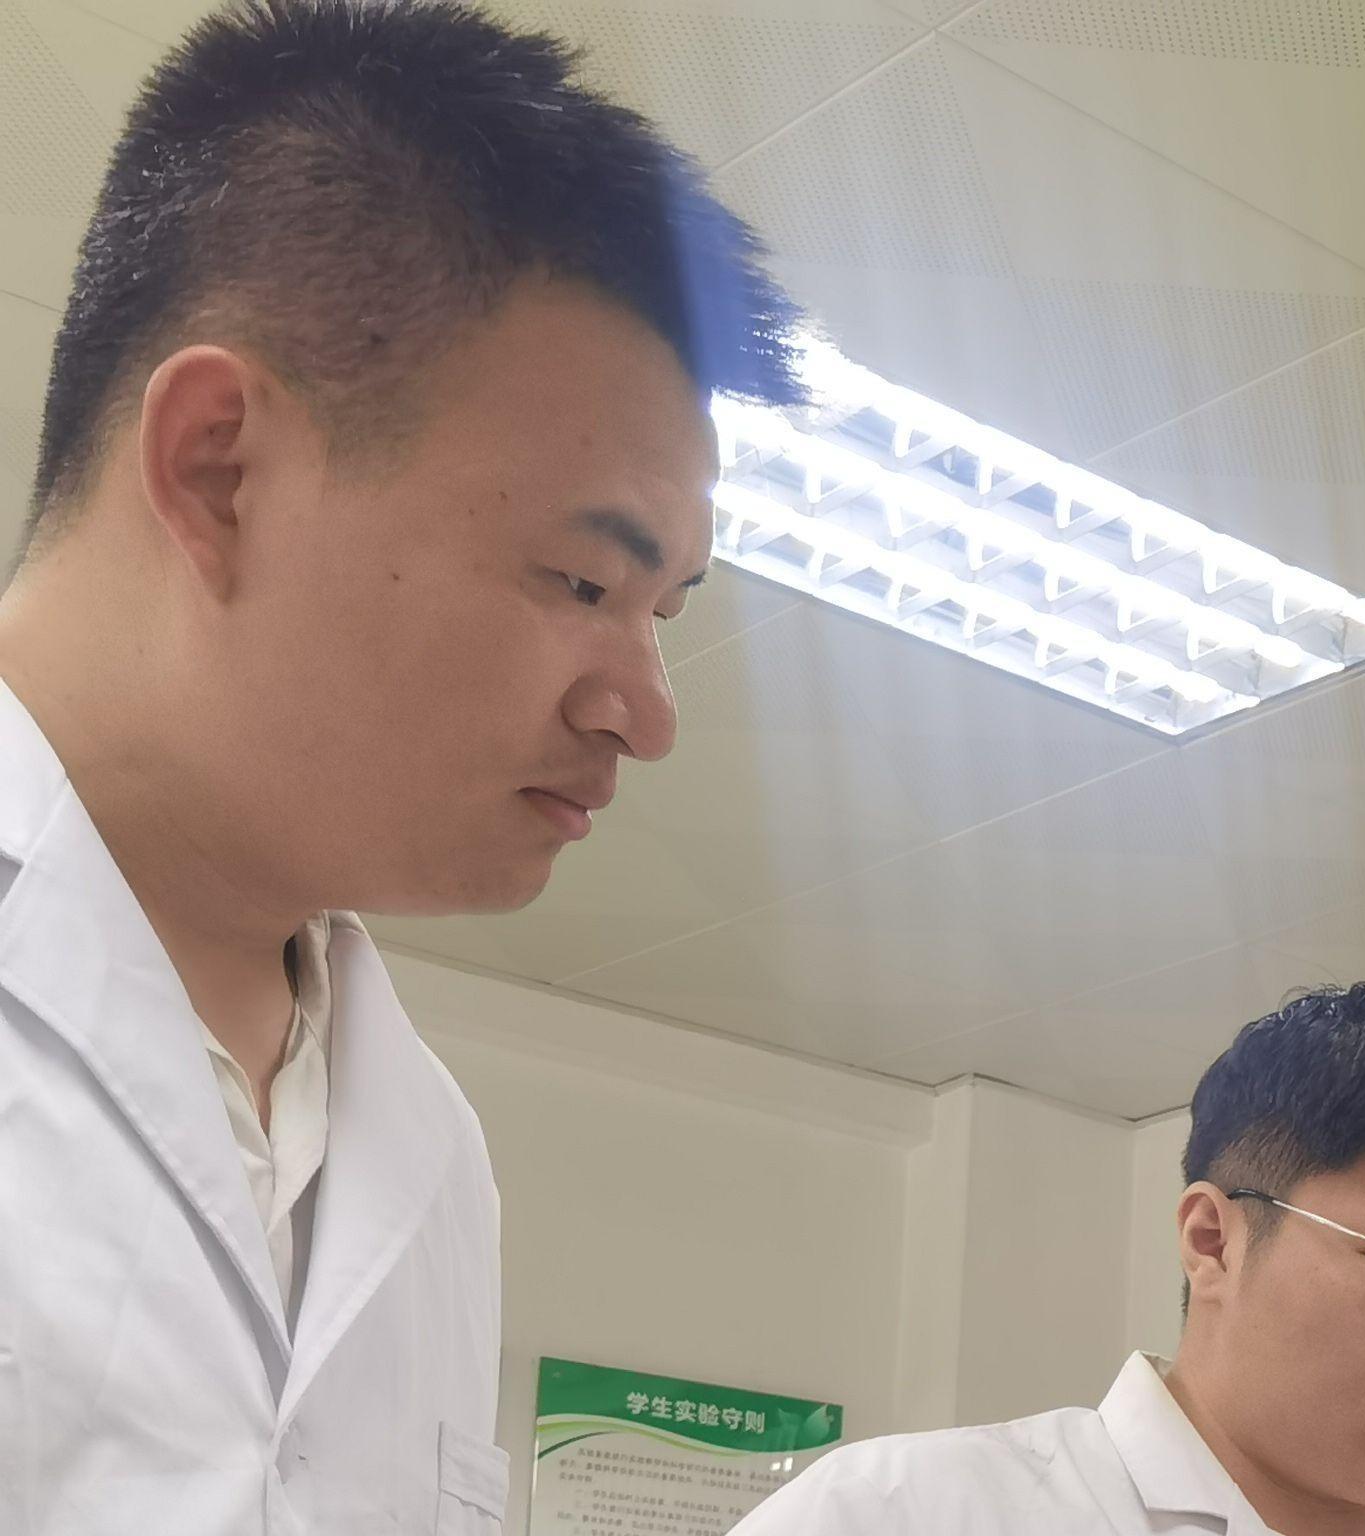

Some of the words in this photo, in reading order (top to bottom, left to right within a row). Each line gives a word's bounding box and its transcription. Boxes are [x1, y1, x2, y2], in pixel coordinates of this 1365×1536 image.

[626, 1391, 766, 1434] 学生实验守则
